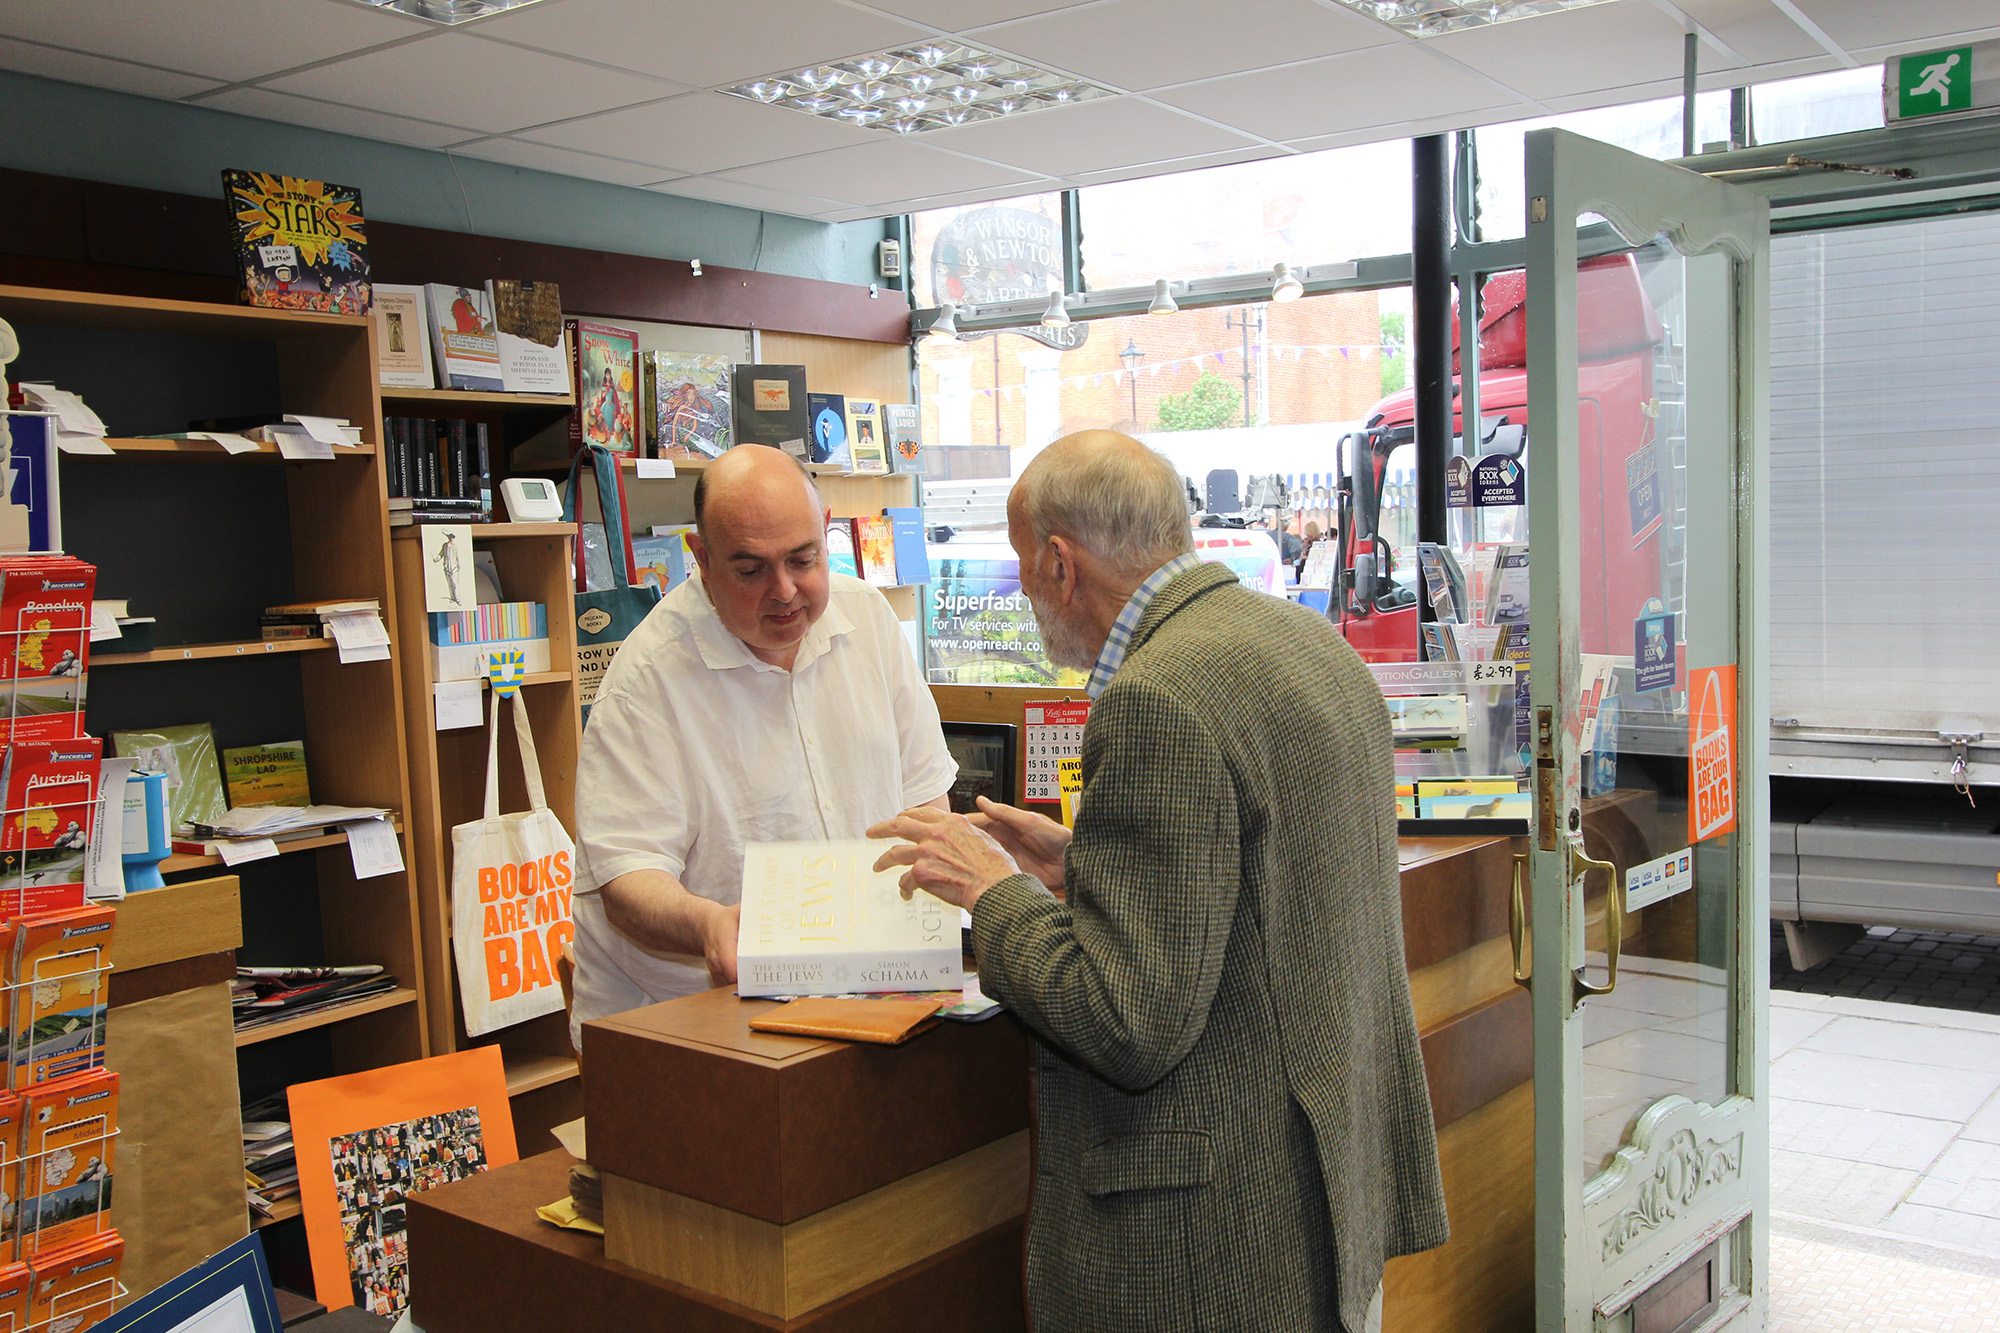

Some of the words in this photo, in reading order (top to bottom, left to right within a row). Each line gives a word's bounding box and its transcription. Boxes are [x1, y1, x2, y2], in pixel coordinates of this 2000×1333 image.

[286, 192, 316, 204] STORY
[263, 198, 342, 238] STARS
[974, 217, 1050, 246] WINSOR
[966, 248, 980, 268] &
[982, 239, 1062, 270] NEWTON
[584, 334, 610, 351] Snow
[602, 348, 630, 368] White
[892, 408, 916, 418] PAINTED
[894, 418, 916, 428] LADIES
[1479, 471, 1498, 480] BOOK
[1638, 481, 1652, 506] OPEN
[860, 521, 894, 540] MARTIN
[636, 550, 666, 558] inderella
[26, 599, 84, 614] Benelux
[933, 588, 1023, 615] Superfast
[932, 616, 950, 630] For
[952, 616, 967, 630] TV
[970, 617, 1013, 632] services
[930, 637, 1044, 652] www.openreach.co.
[1508, 650, 1523, 659] idea
[578, 662, 598, 673] ND
[233, 751, 295, 766] SHROPSHIRE
[1696, 734, 1726, 772] BOOKS
[256, 764, 277, 775] LAD
[1698, 766, 1712, 792] ARE
[1712, 758, 1727, 781] OUR
[27, 771, 91, 787] Australia
[1028, 774, 1036, 782] 22
[1040, 774, 1048, 782] 23
[1051, 774, 1059, 782] 24
[1698, 777, 1730, 831] BAG
[478, 850, 573, 904] BOOKS
[762, 856, 778, 906] STORY
[1630, 876, 1639, 885] VISA
[781, 872, 798, 904] THE
[800, 854, 842, 944] JEWS
[483, 898, 530, 938] ARE
[535, 886, 574, 926] MY
[780, 910, 795, 931] OF
[922, 901, 942, 942] SCH
[72, 924, 110, 935] MICHELIN
[760, 914, 776, 946] THE
[753, 972, 782, 982] THE
[789, 971, 824, 983] JEWS
[860, 969, 929, 982] SCHAMA
[76, 1090, 109, 1103] MICHELIN
